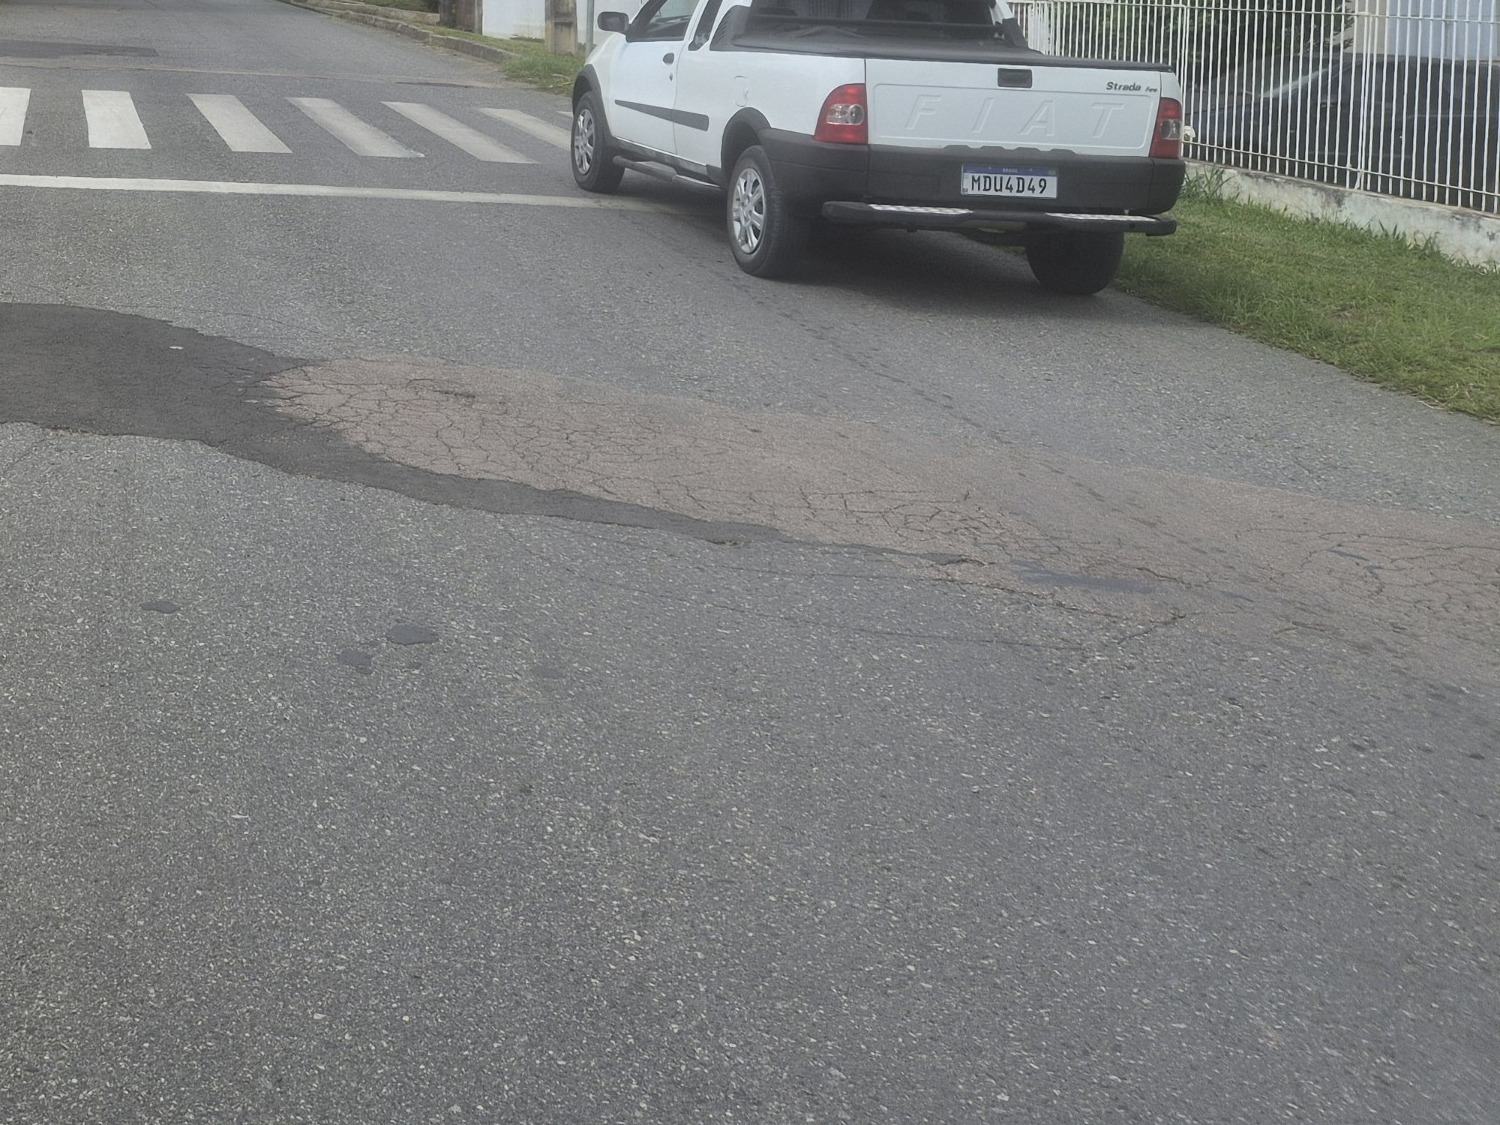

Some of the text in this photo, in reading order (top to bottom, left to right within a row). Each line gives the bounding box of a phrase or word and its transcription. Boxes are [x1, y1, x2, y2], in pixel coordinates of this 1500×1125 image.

[1106, 81, 1141, 91] Strada
[905, 94, 1124, 139] FIAT
[971, 175, 1047, 194] MDU4D49
